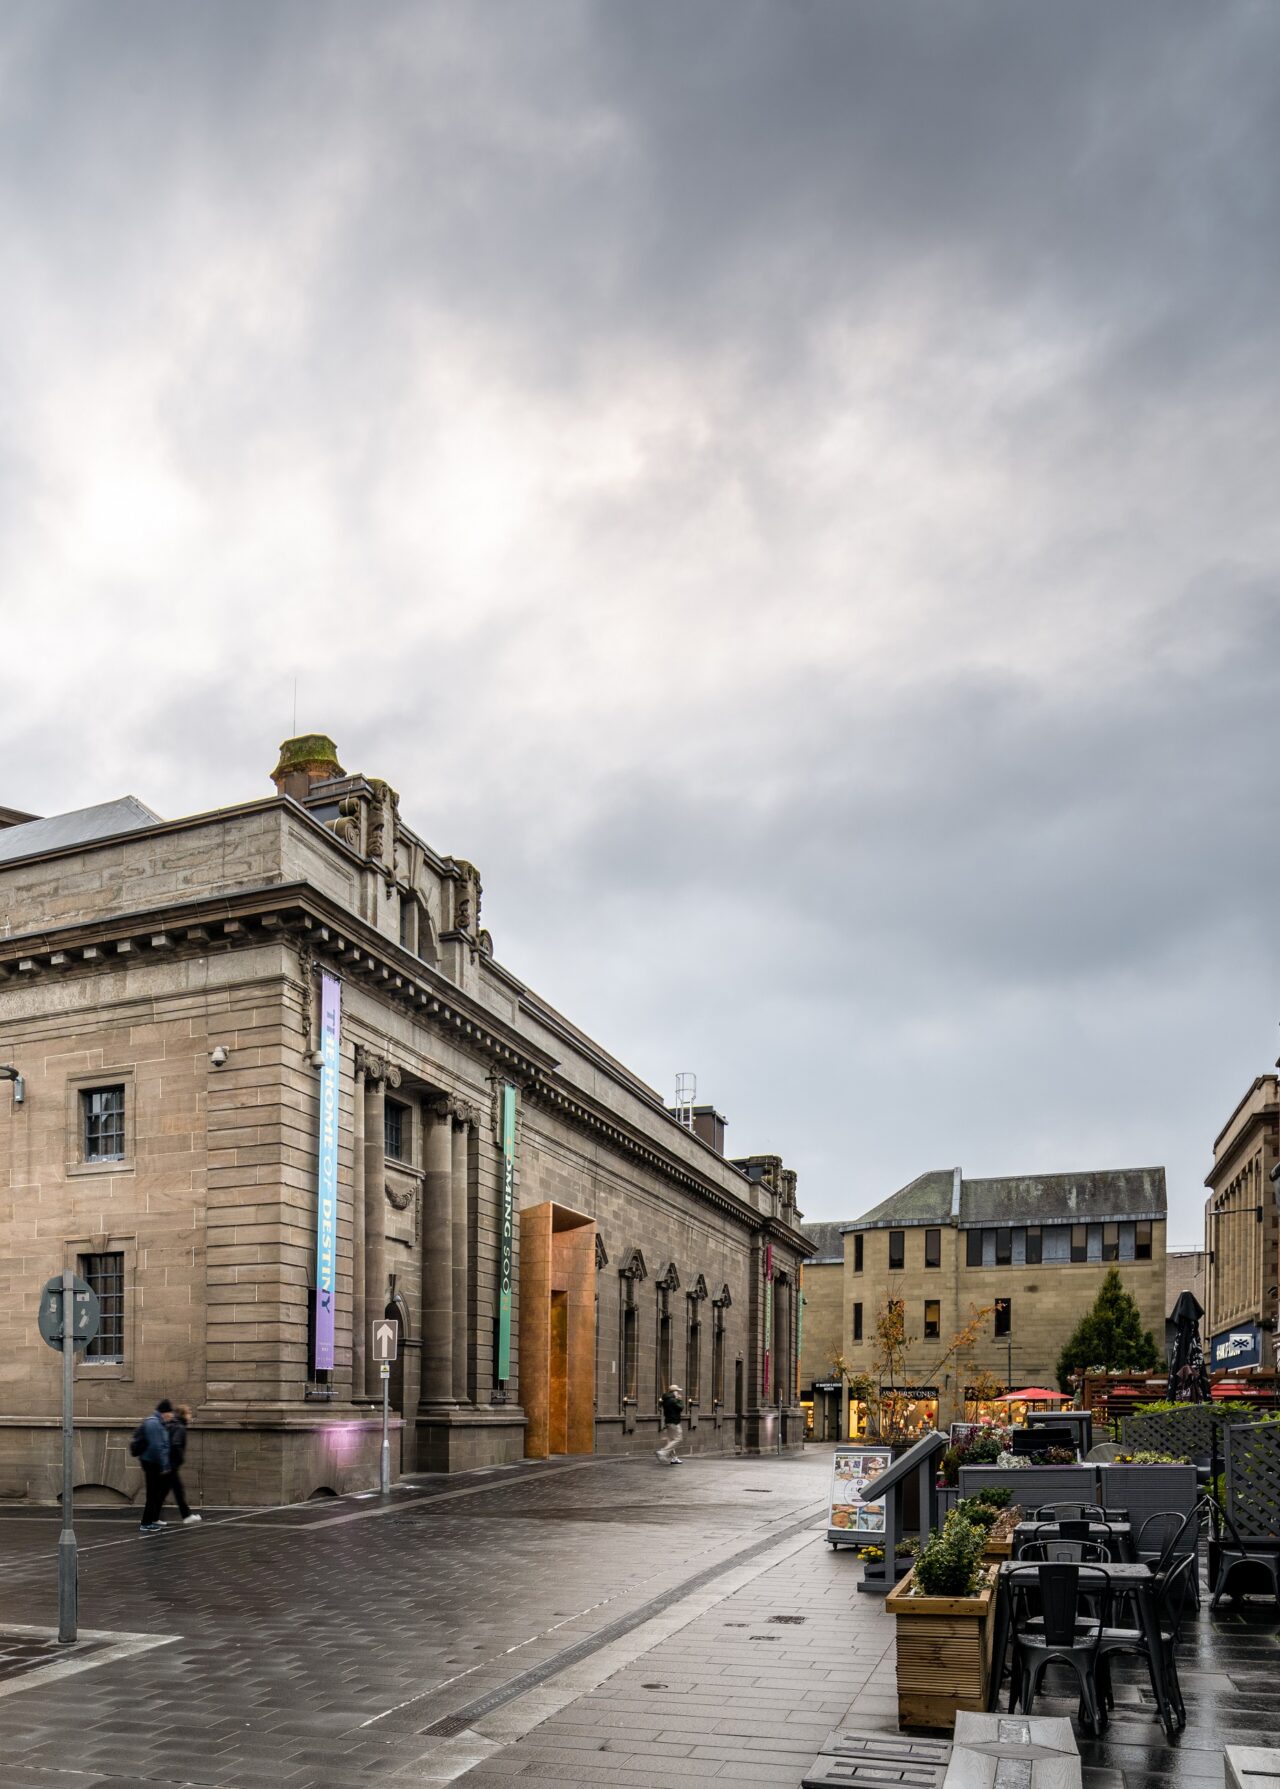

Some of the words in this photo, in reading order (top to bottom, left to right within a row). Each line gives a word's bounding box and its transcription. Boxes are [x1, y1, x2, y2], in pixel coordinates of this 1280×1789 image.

[325, 1008, 336, 1061] THE
[324, 1067, 335, 1149] HOME
[323, 1155, 333, 1193] OF
[321, 1198, 332, 1314] DESTINY
[881, 1390, 937, 1398] WAERSTONES
